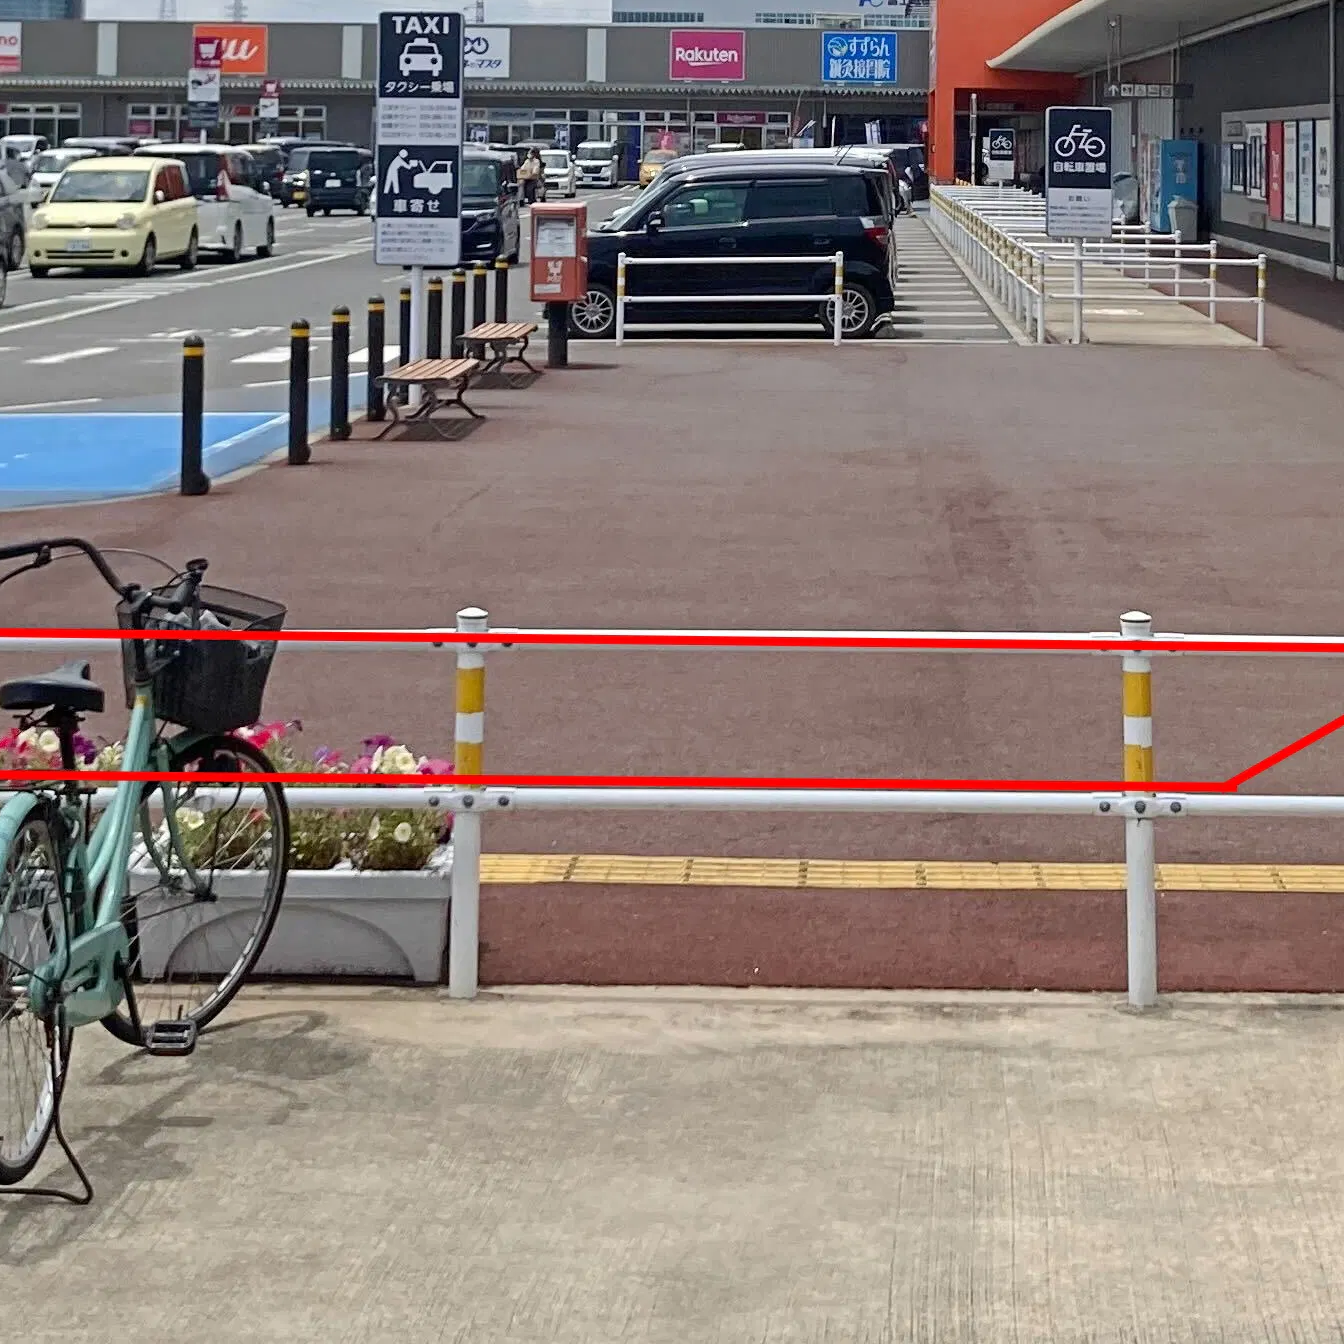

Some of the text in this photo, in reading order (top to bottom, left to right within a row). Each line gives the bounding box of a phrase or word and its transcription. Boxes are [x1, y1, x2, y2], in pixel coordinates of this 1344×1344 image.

[392, 16, 450, 34] TAXI
[675, 46, 738, 63] Rakuten
[848, 36, 890, 57] すずらん
[384, 80, 455, 94] タクシー乗場
[393, 198, 441, 214] 車寄せ
